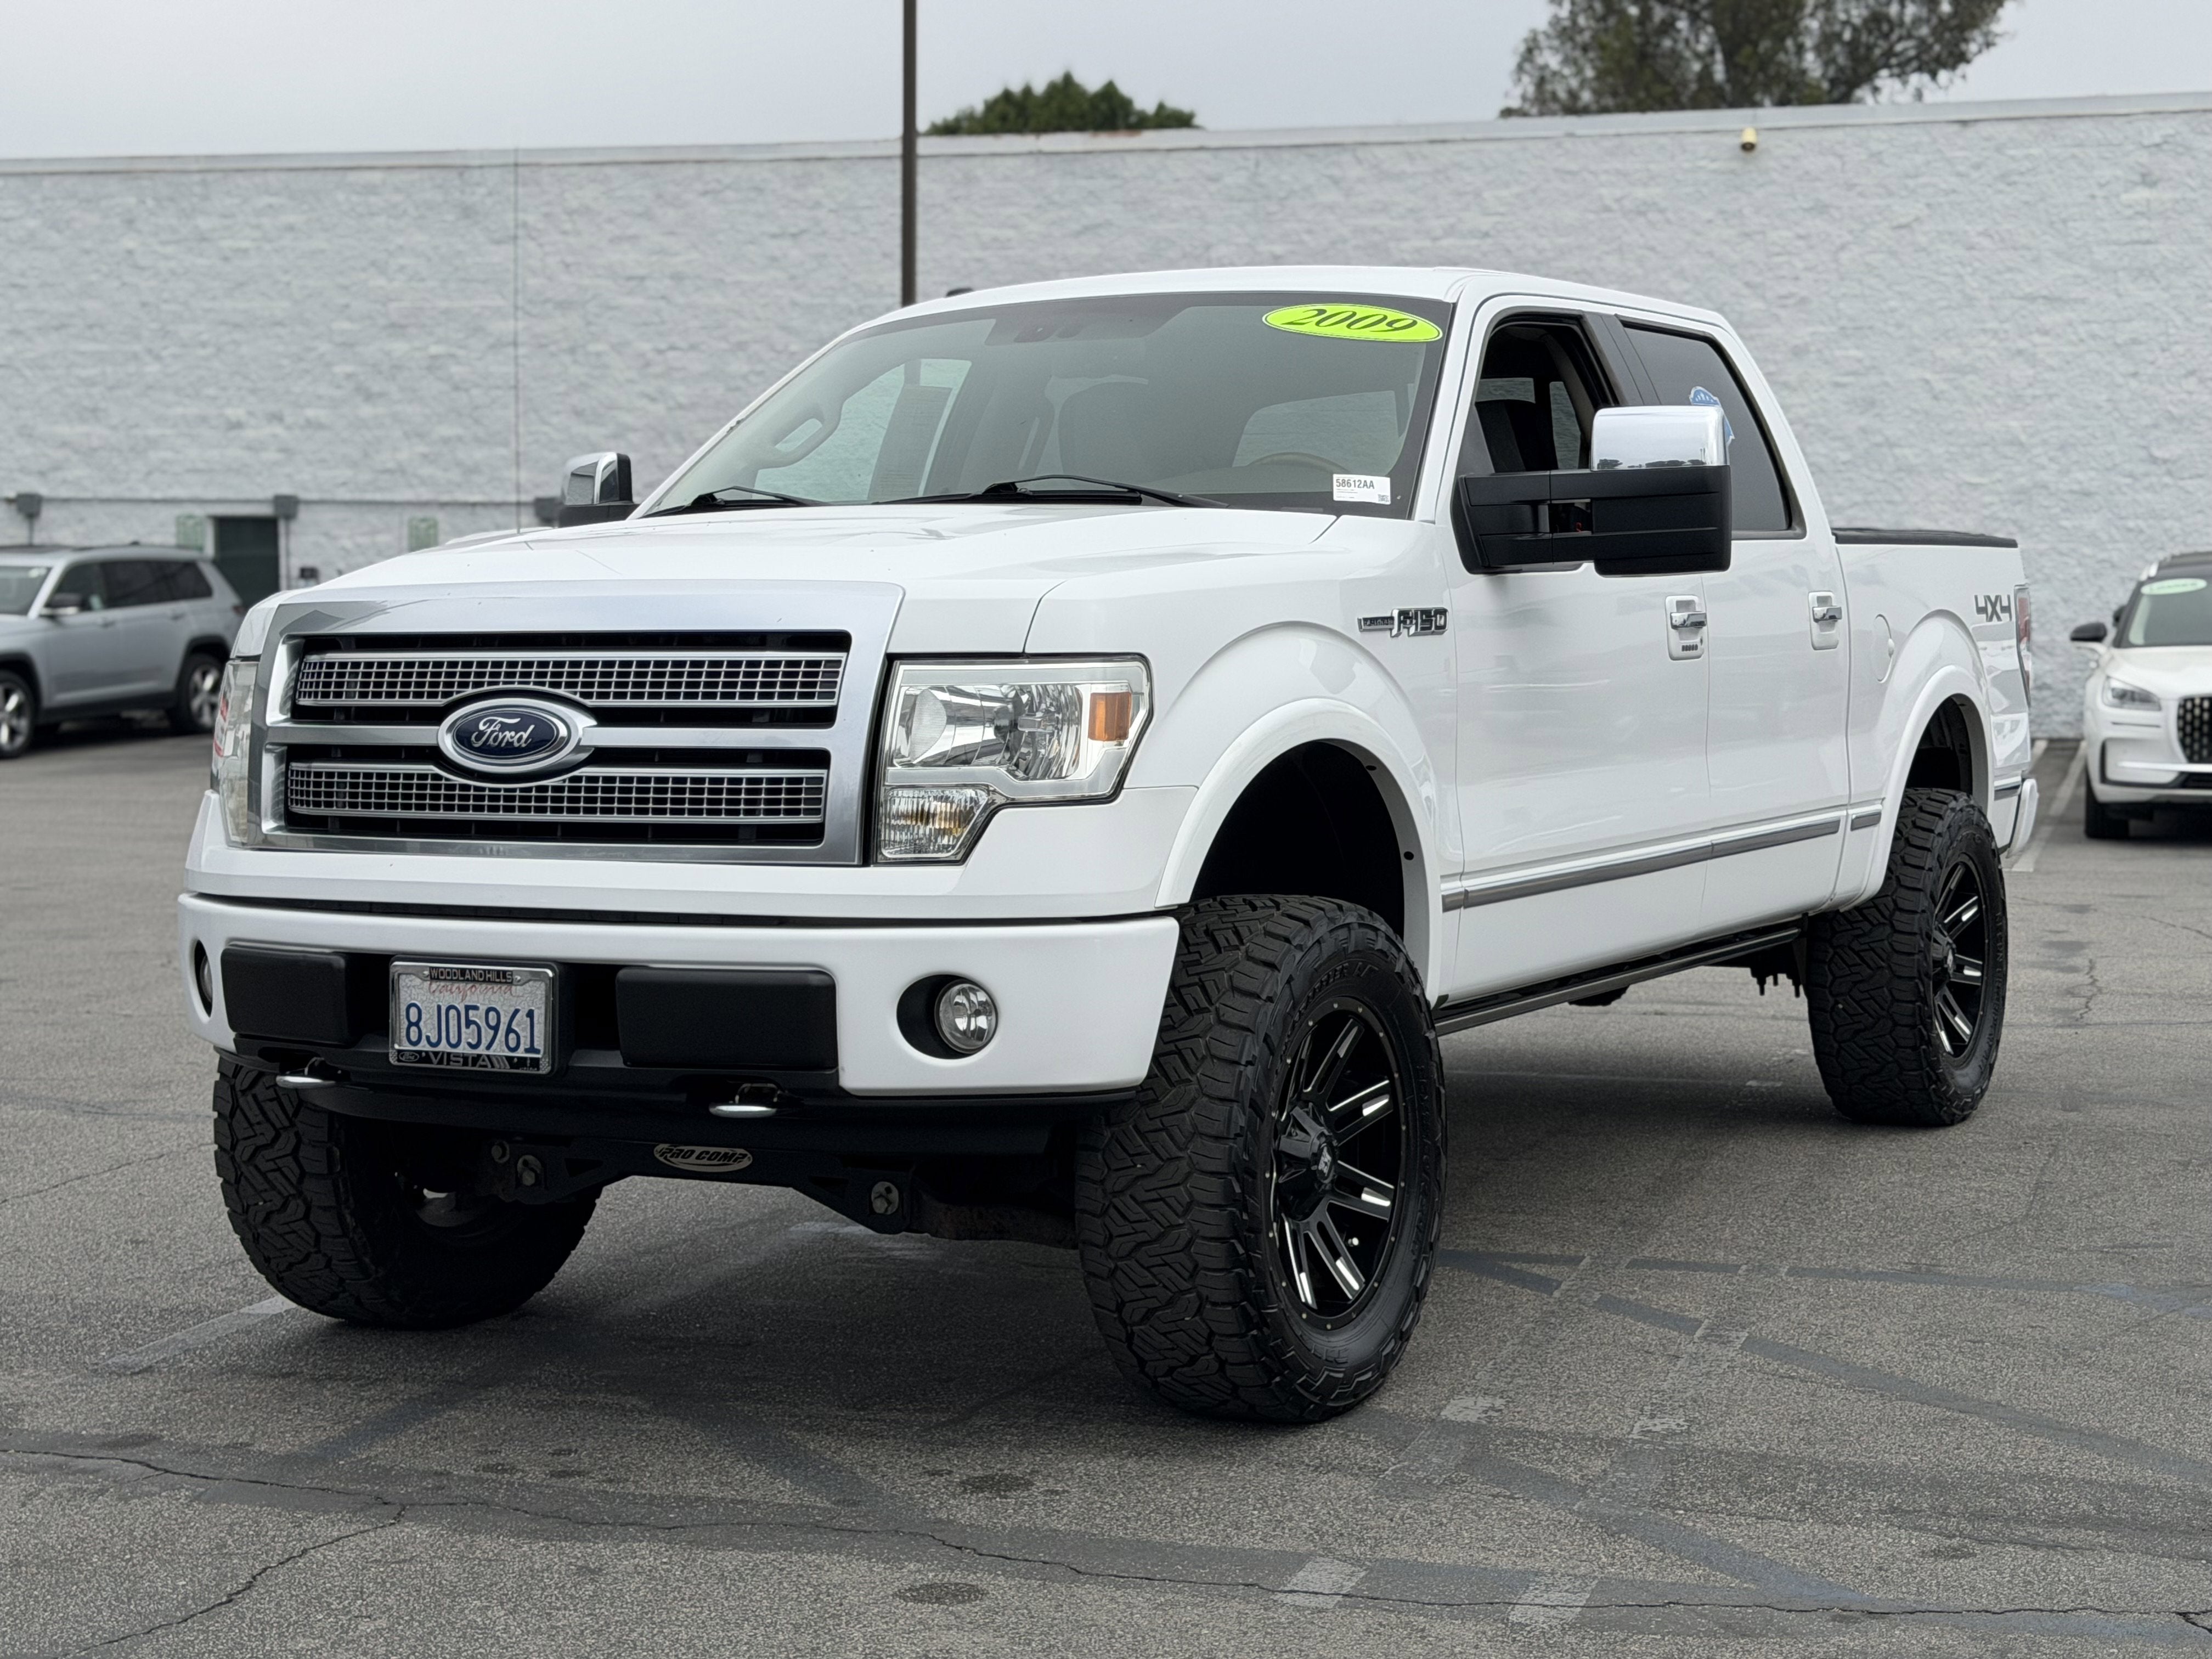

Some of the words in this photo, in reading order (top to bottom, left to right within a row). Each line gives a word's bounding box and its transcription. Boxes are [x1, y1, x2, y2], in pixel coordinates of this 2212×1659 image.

[1281, 308, 1418, 332] 2009
[1336, 478, 1375, 489] 58612AA
[471, 716, 535, 747] Ford
[430, 968, 484, 981] WOODLAND
[486, 970, 513, 983] HILLS
[405, 1002, 541, 1054] 8J05961
[429, 1052, 492, 1069] VISTA
[659, 1147, 695, 1159] PRO
[695, 1150, 748, 1163] COMP
